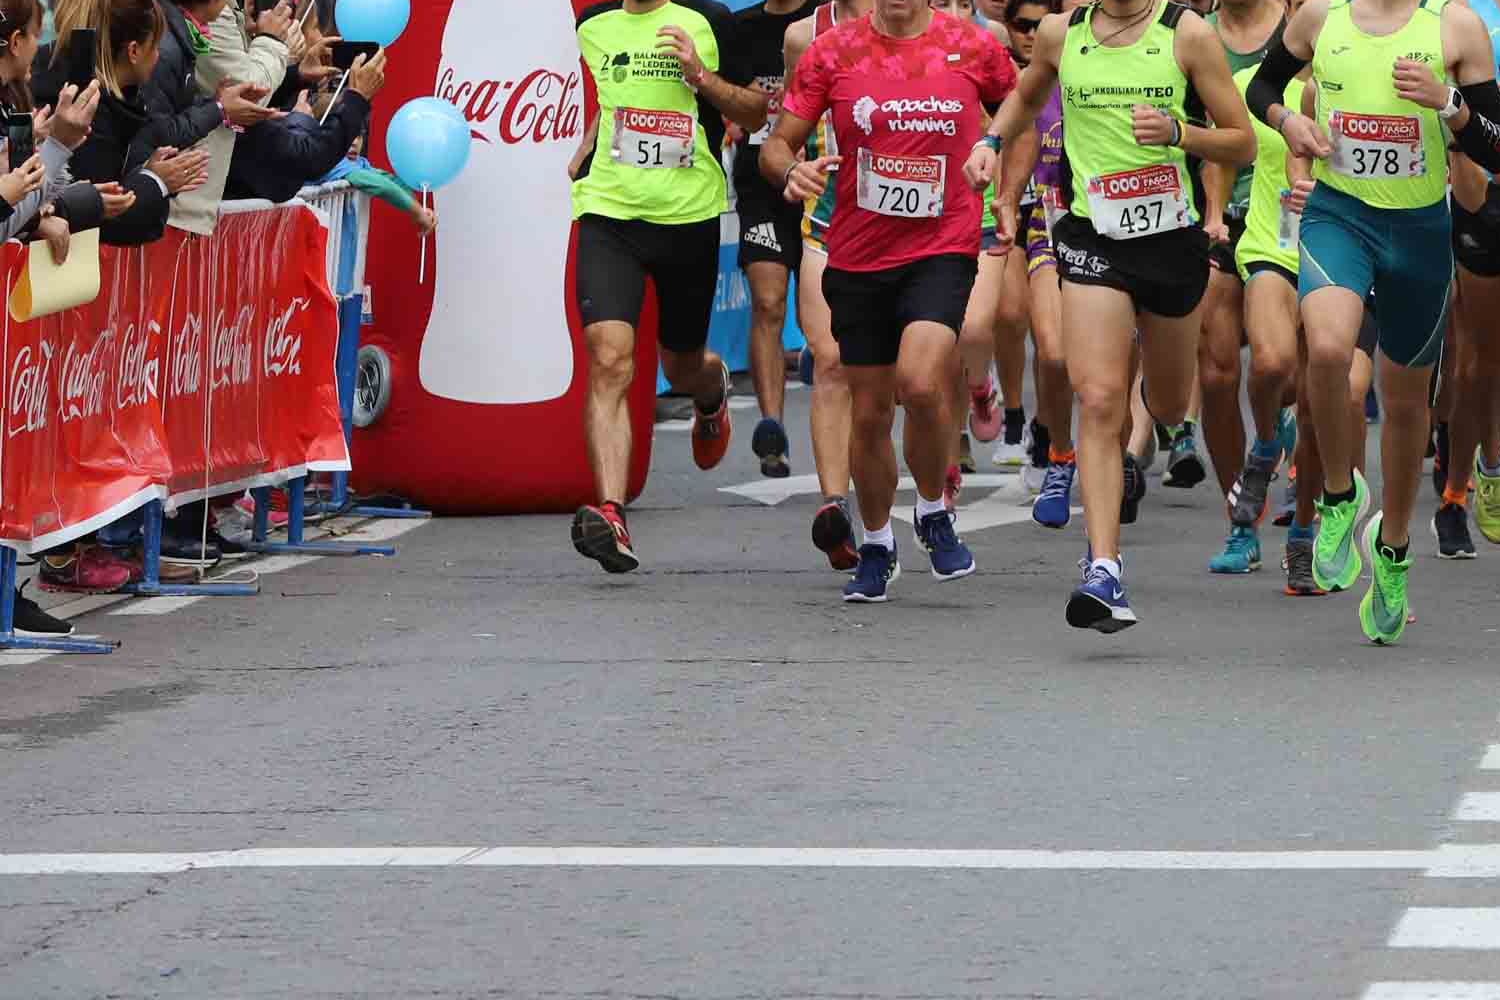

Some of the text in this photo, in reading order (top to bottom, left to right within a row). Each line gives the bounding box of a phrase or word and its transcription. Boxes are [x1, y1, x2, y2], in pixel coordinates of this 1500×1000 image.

[1143, 86, 1174, 98] TEO
[881, 96, 963, 118] apaches
[888, 117, 956, 136] running
[637, 140, 664, 166] 51
[1352, 148, 1400, 175] 378
[878, 183, 920, 214] 720
[1119, 201, 1164, 234] 437
[743, 232, 782, 252] adidas
